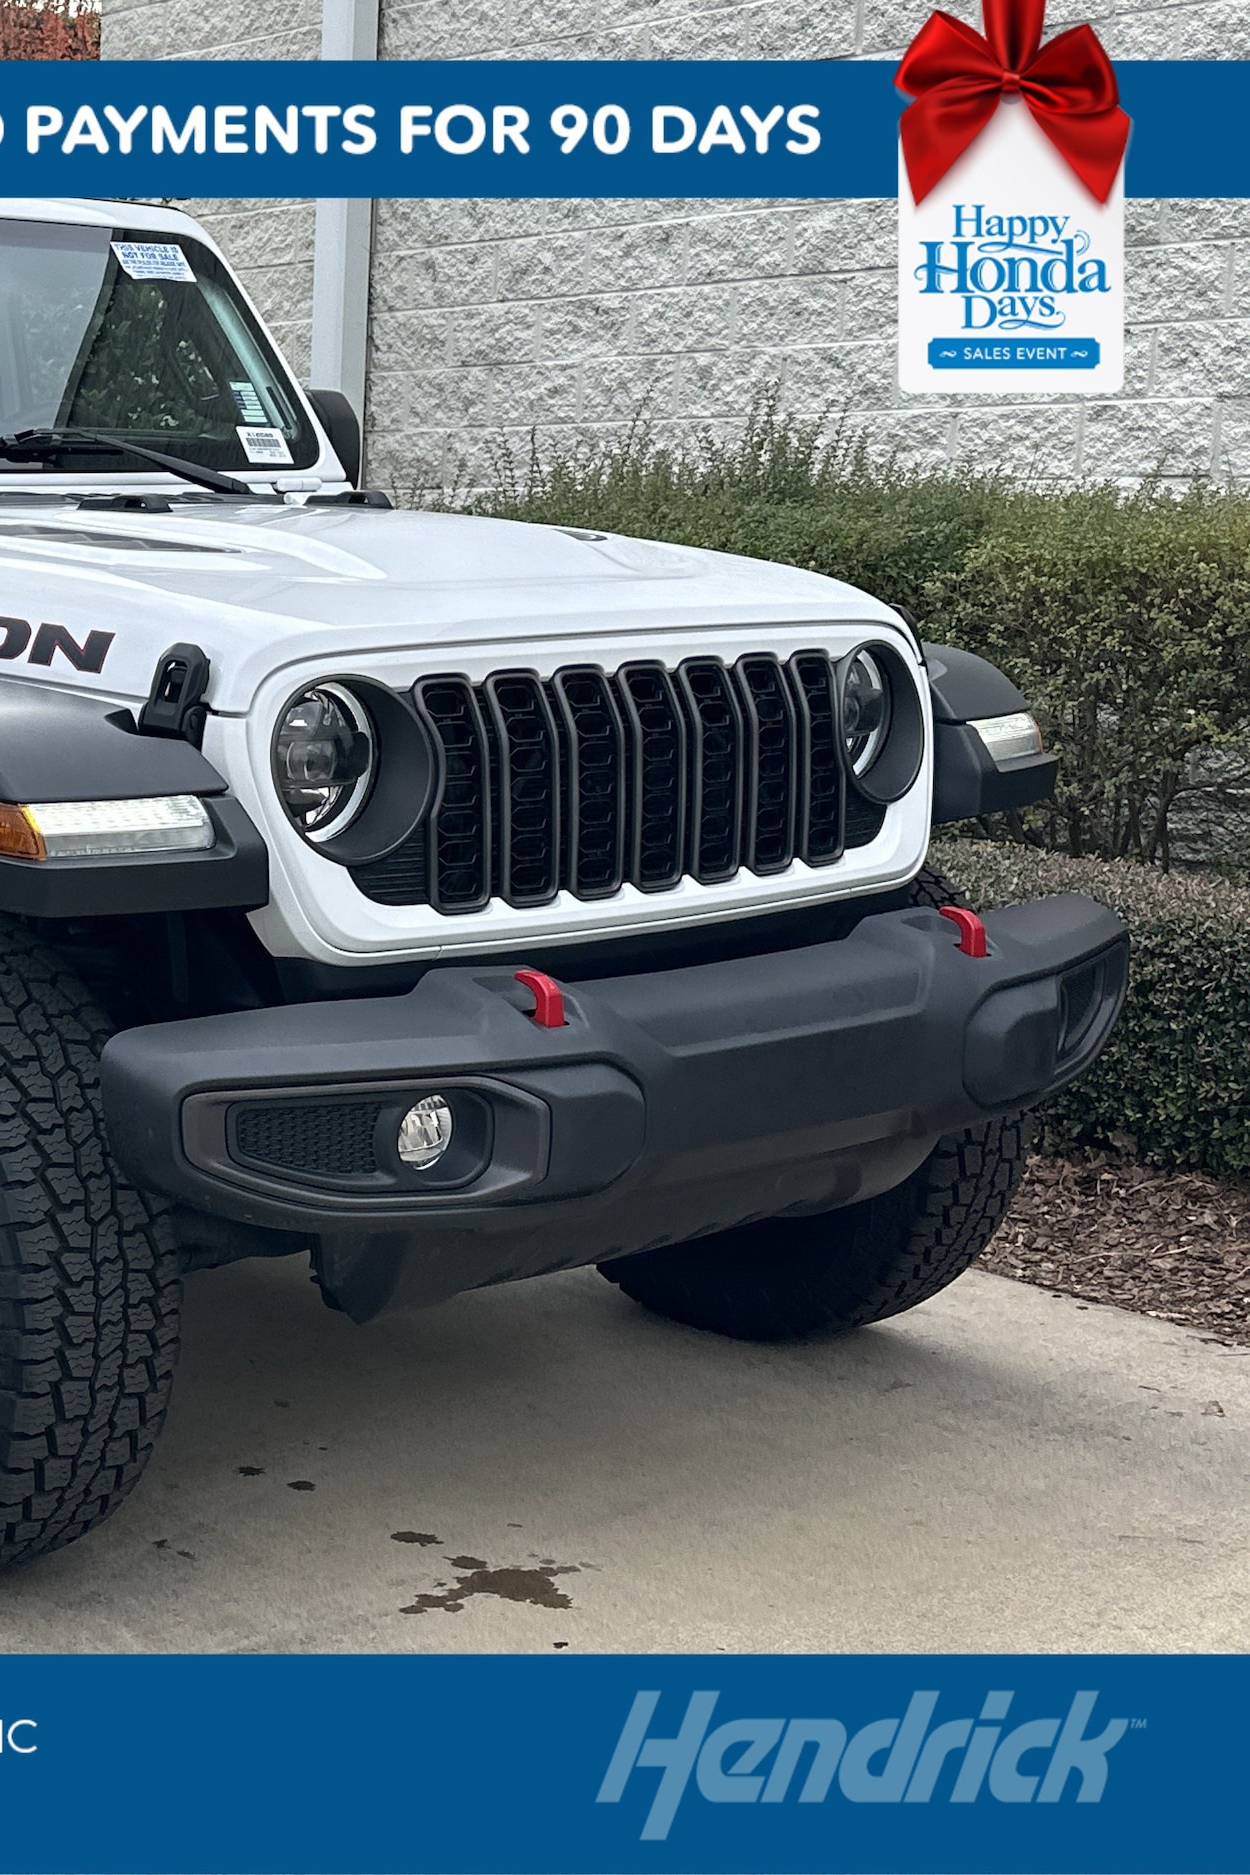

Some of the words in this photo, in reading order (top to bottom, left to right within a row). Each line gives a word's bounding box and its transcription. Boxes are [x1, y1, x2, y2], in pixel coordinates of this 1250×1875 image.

[135, 244, 169, 253] VEHICLE
[122, 251, 138, 259] NOT
[140, 252, 157, 260] FOR
[158, 253, 179, 261] SALE
